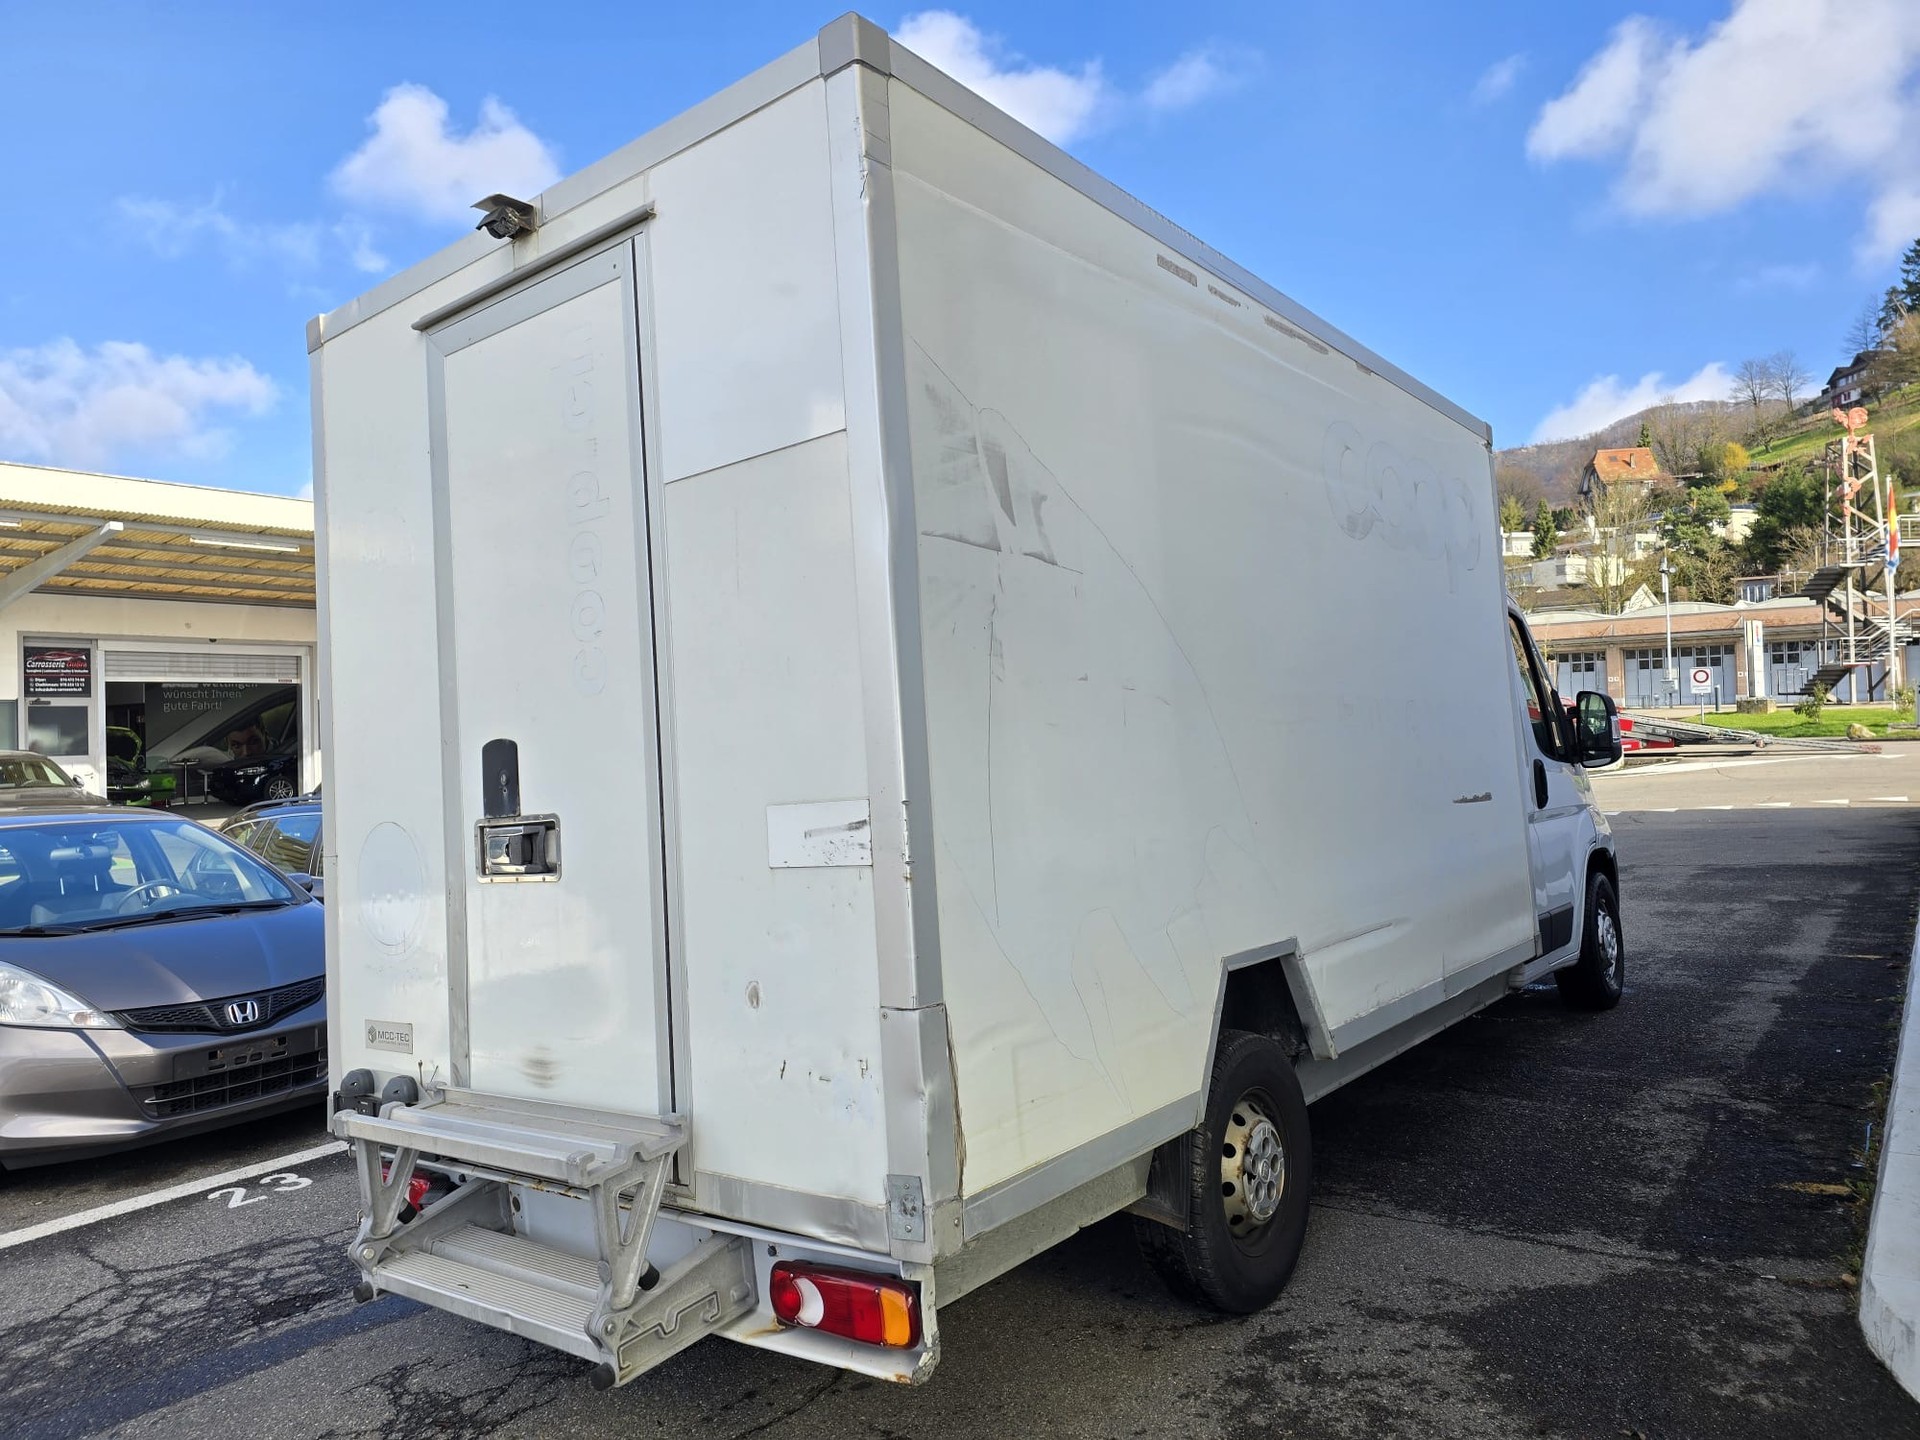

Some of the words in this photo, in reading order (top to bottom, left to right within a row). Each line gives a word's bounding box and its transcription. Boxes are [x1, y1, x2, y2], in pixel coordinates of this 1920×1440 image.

[26, 660, 66, 668] Carrosserie
[163, 689, 209, 699] wünscht
[212, 689, 242, 699] Ihnen
[163, 702, 188, 713] gute
[191, 701, 222, 711] Fahrt!
[207, 1172, 314, 1209] 23
